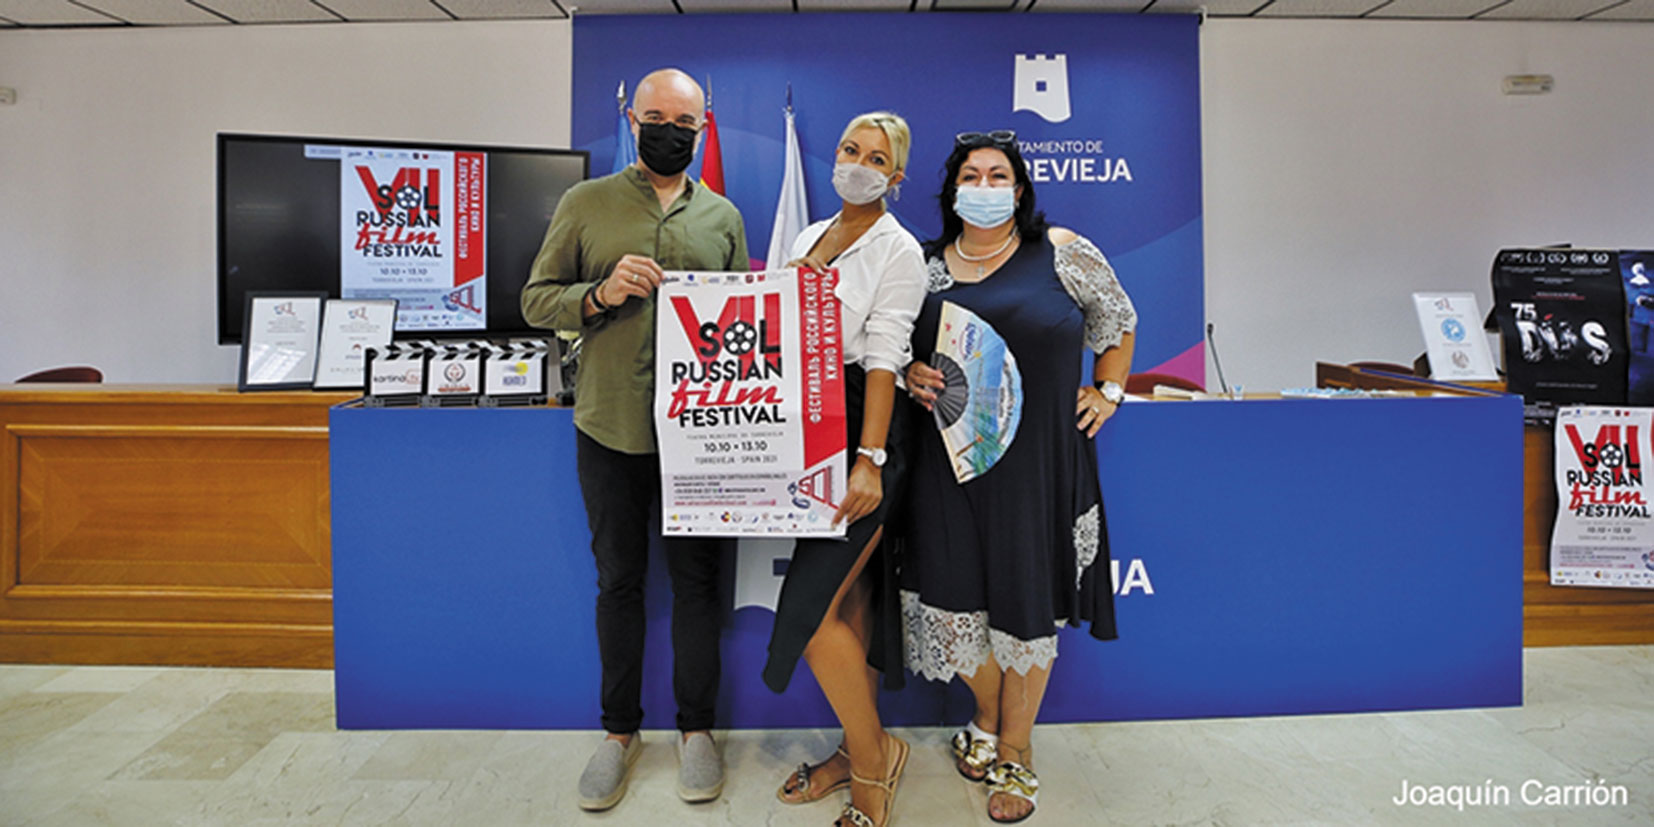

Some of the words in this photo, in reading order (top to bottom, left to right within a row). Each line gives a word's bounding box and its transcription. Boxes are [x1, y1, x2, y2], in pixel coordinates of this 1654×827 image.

[1015, 140, 1084, 153] TAMIENTO
[1086, 140, 1103, 153] DE
[377, 184, 440, 210] SOL
[357, 211, 441, 227] RUSSIAN
[354, 223, 441, 250] film
[363, 244, 443, 258] FESTIVAL
[804, 272, 820, 355] РОССИЙСКОГО
[821, 272, 837, 333] КУЛЬТУРЫ
[1510, 303, 1537, 320] 75
[669, 293, 781, 381] VII
[699, 319, 781, 358] SOL
[824, 335, 837, 345] И
[672, 357, 783, 385] RUSSIAN
[824, 347, 838, 380] КИНО
[667, 379, 784, 419] film
[807, 358, 822, 424] ФЕСТИВАЛЬ
[679, 405, 787, 428] FESTIVAL
[704, 441, 731, 453] 10.10
[741, 440, 768, 451] 13.10
[1583, 442, 1641, 469] SOL
[1567, 469, 1643, 487] RUSSIAN
[1568, 481, 1647, 511] film
[1575, 504, 1651, 519] FESTIVAL
